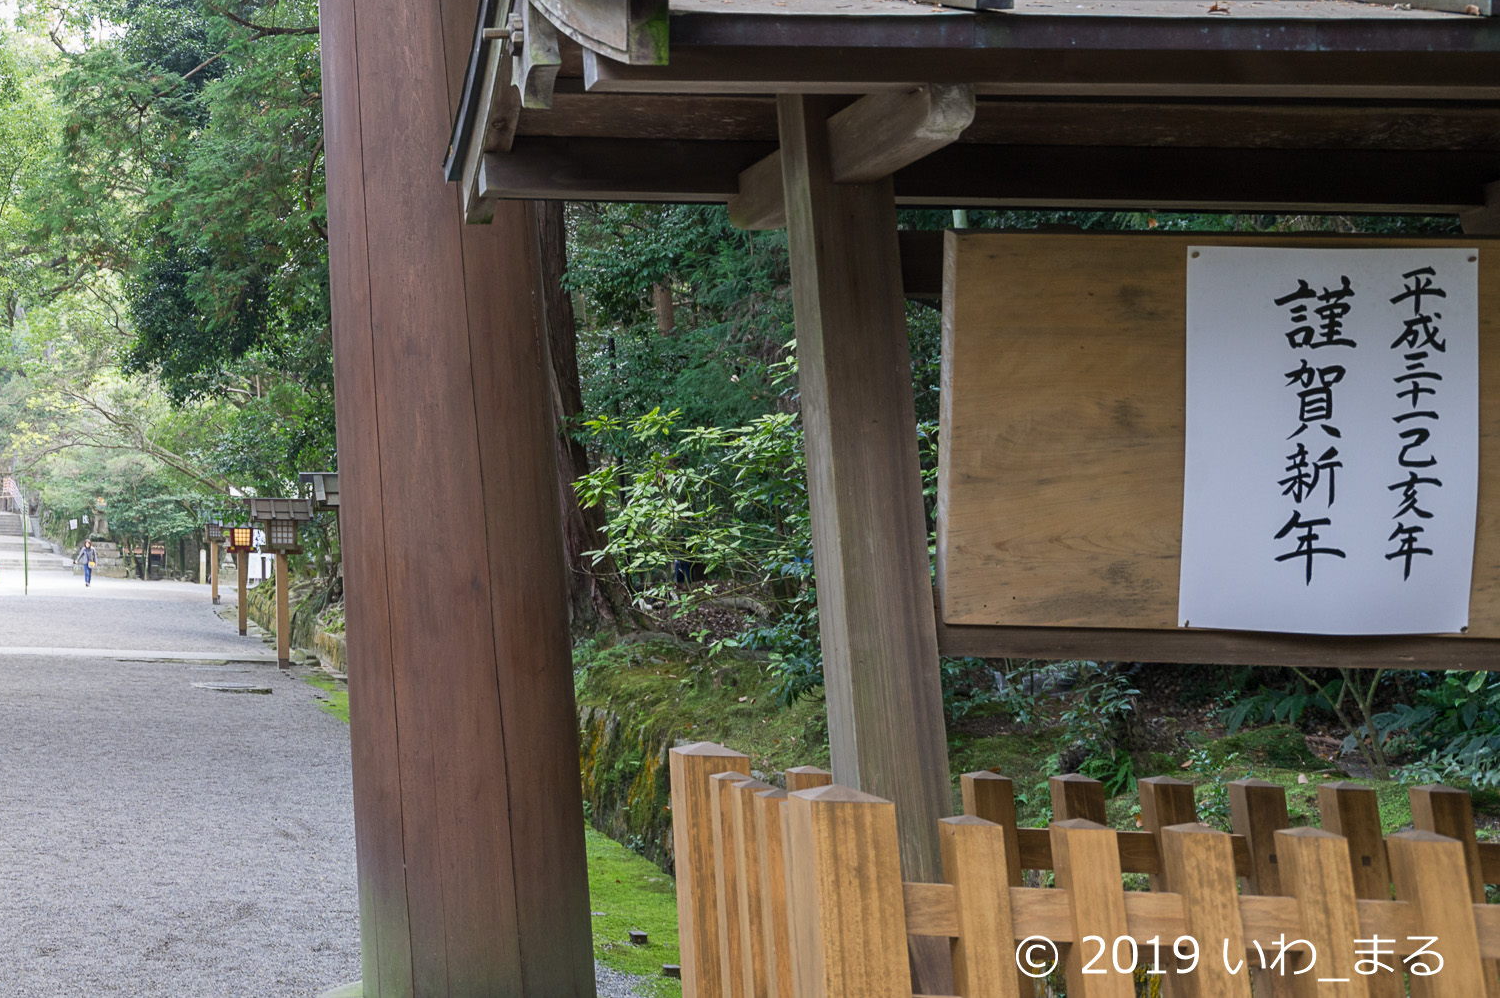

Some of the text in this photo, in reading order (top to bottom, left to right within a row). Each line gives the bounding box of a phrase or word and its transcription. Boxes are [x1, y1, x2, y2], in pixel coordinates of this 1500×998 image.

[1274, 275, 1357, 586] 謹賀新年
[1385, 266, 1447, 581] 平成三十一己亥年
